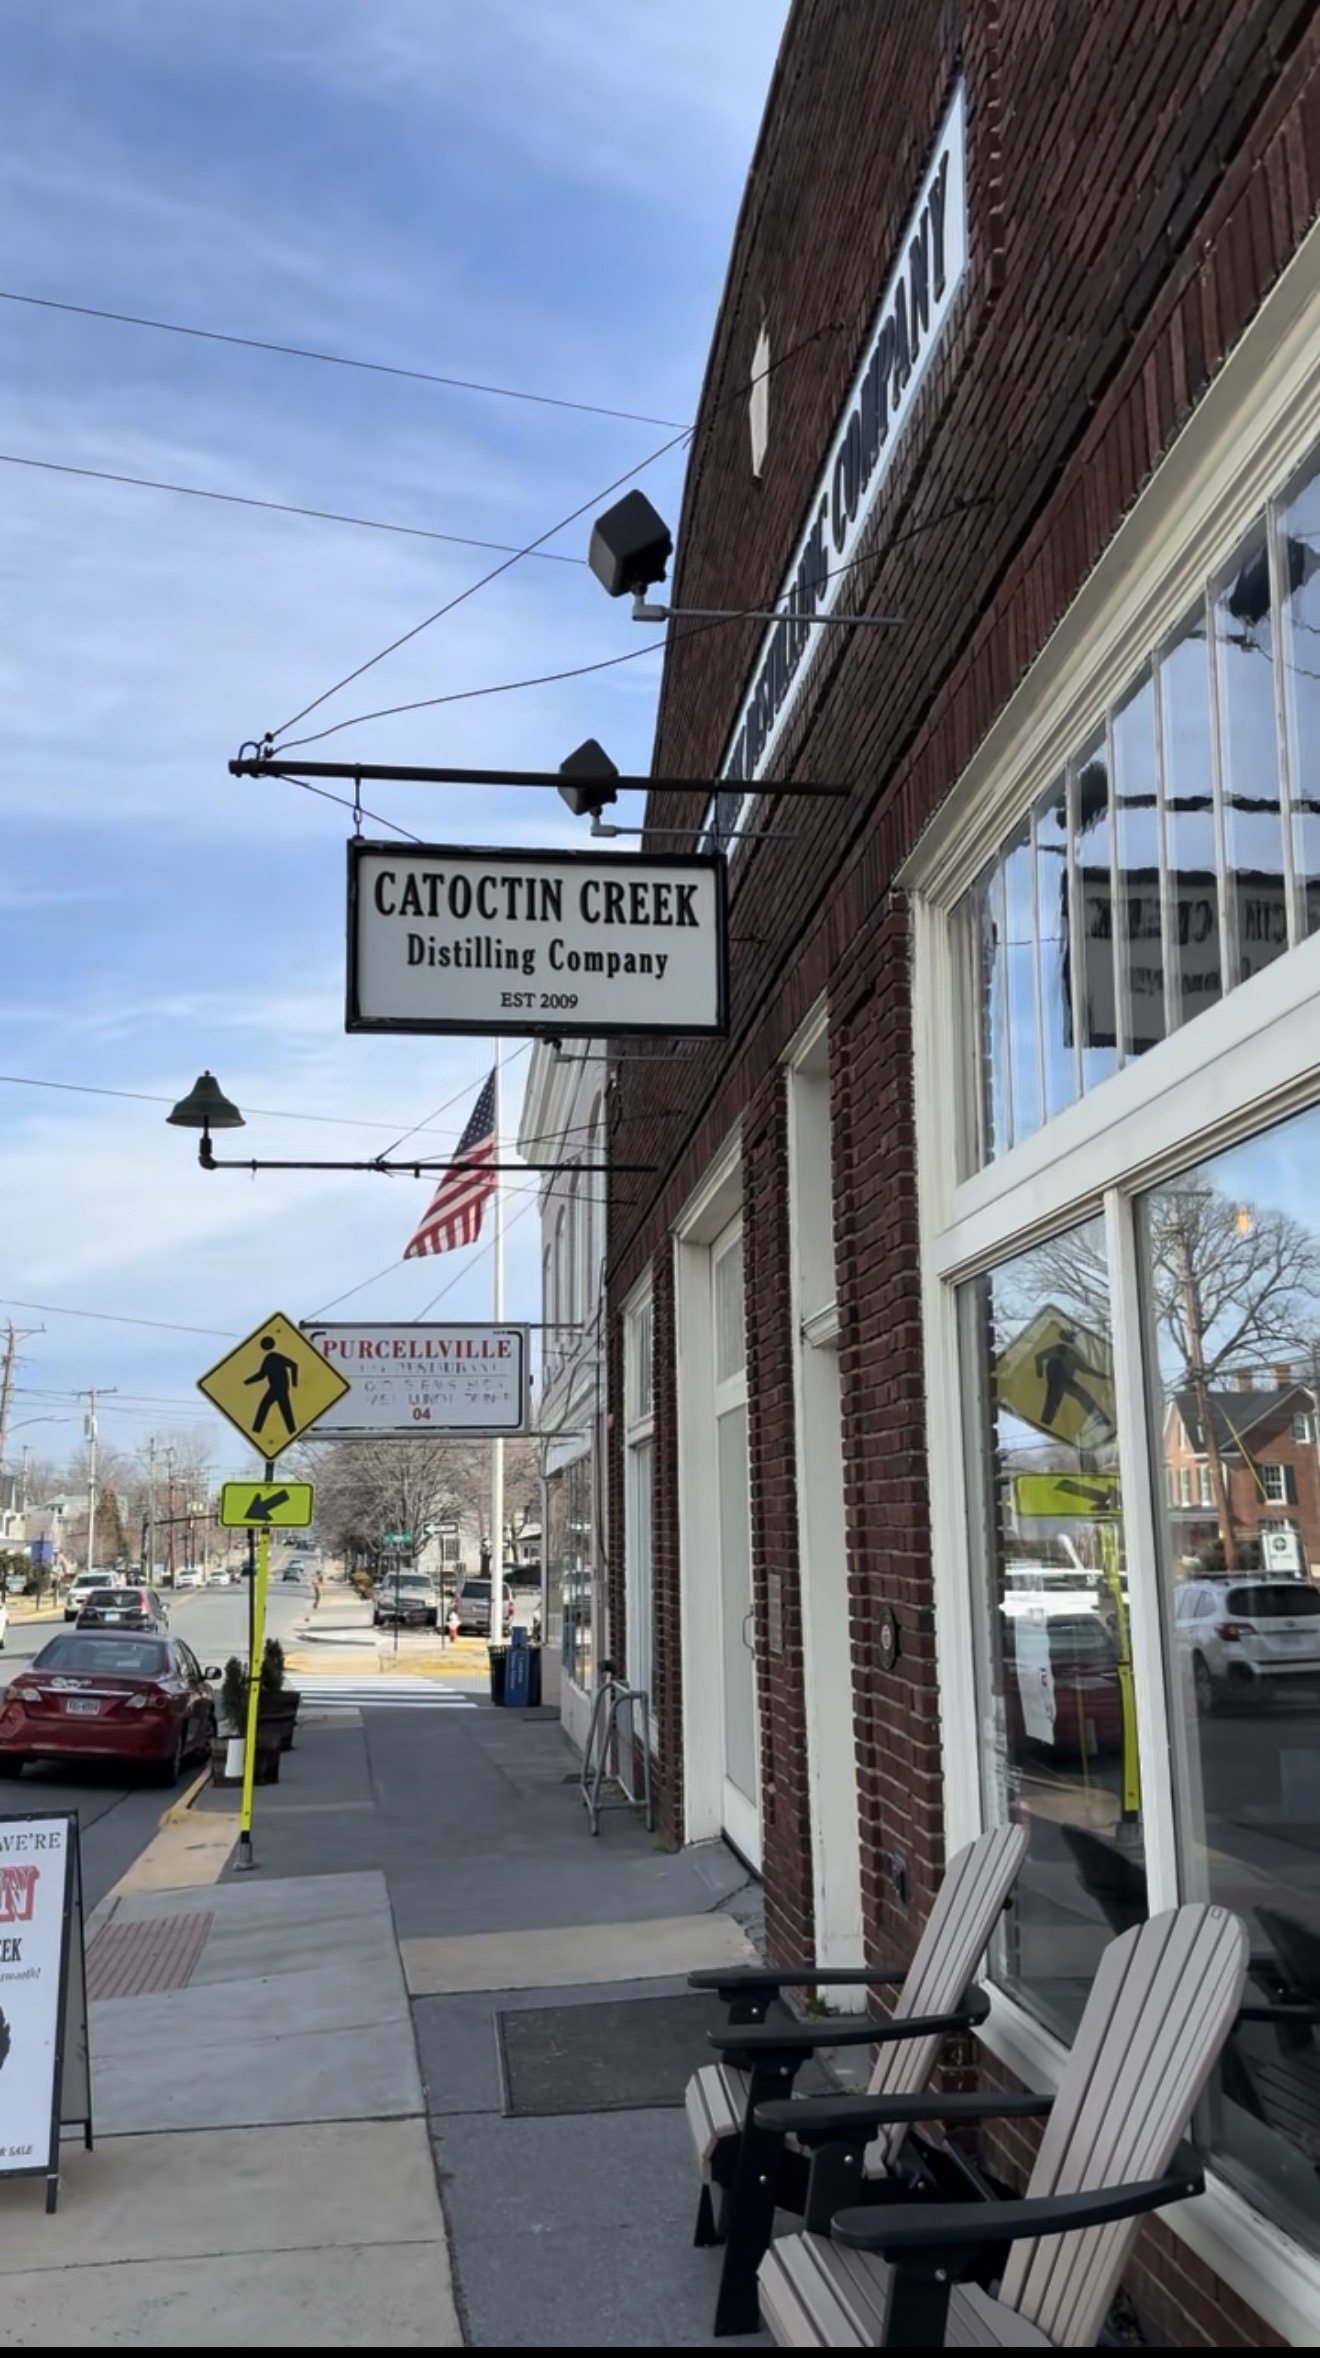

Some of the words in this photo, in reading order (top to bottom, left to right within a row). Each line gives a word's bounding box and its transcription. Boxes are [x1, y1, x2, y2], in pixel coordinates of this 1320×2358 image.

[832, 148, 950, 556] COMPANY
[374, 871, 563, 921] CATOCTIN
[579, 880, 699, 927] CREEK
[407, 933, 536, 975] Distilling
[548, 938, 668, 979] Company
[500, 992, 535, 1008] EST
[539, 993, 578, 1009] 2009
[323, 1339, 512, 1360] PURCELLVILLE
[412, 1407, 431, 1420] 04
